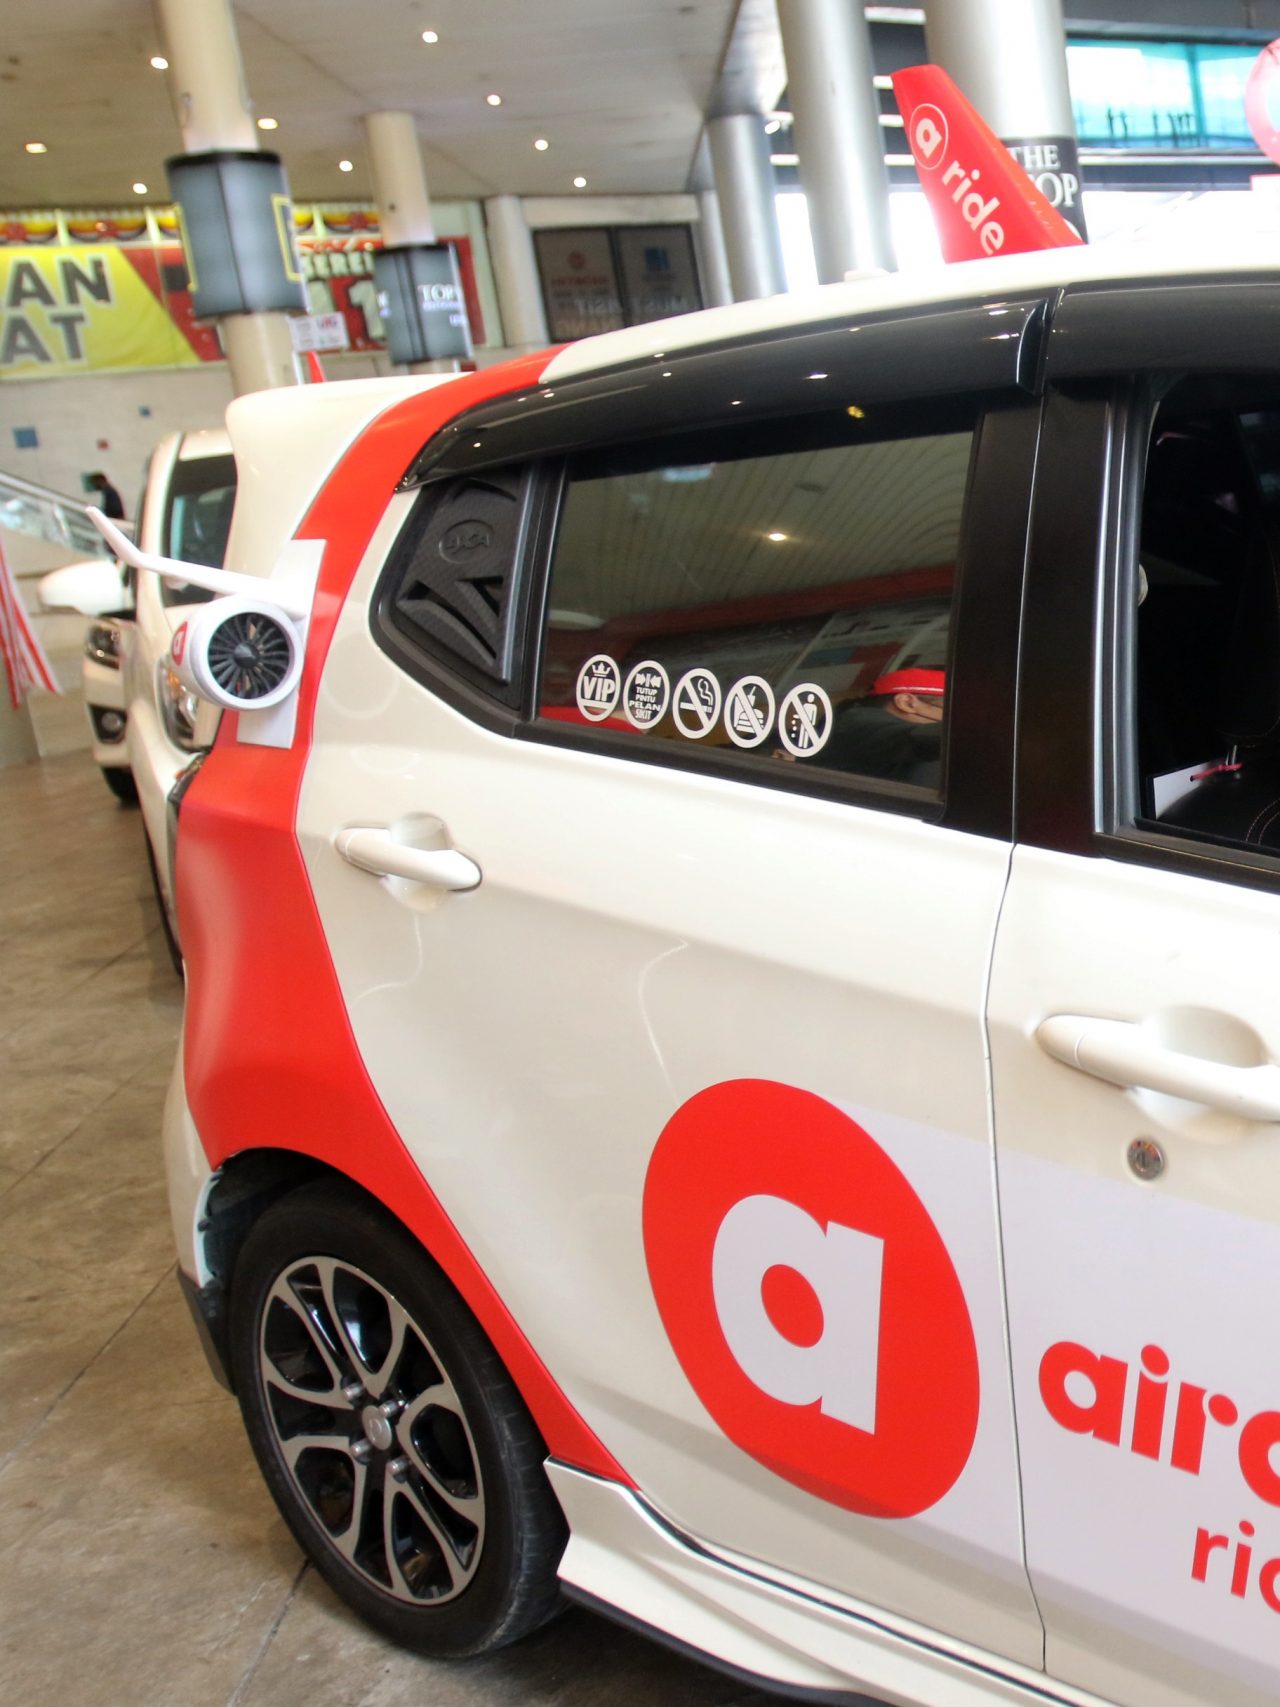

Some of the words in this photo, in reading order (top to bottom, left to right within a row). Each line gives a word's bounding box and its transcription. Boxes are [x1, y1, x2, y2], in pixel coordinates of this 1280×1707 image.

[1030, 172, 1079, 208] OP
[941, 160, 1004, 255] ride
[584, 676, 616, 702] VIP
[636, 686, 658, 696] TUTUP
[635, 694, 657, 704] PINTU
[629, 700, 661, 712] PELAN
[635, 709, 653, 720] SIKIT
